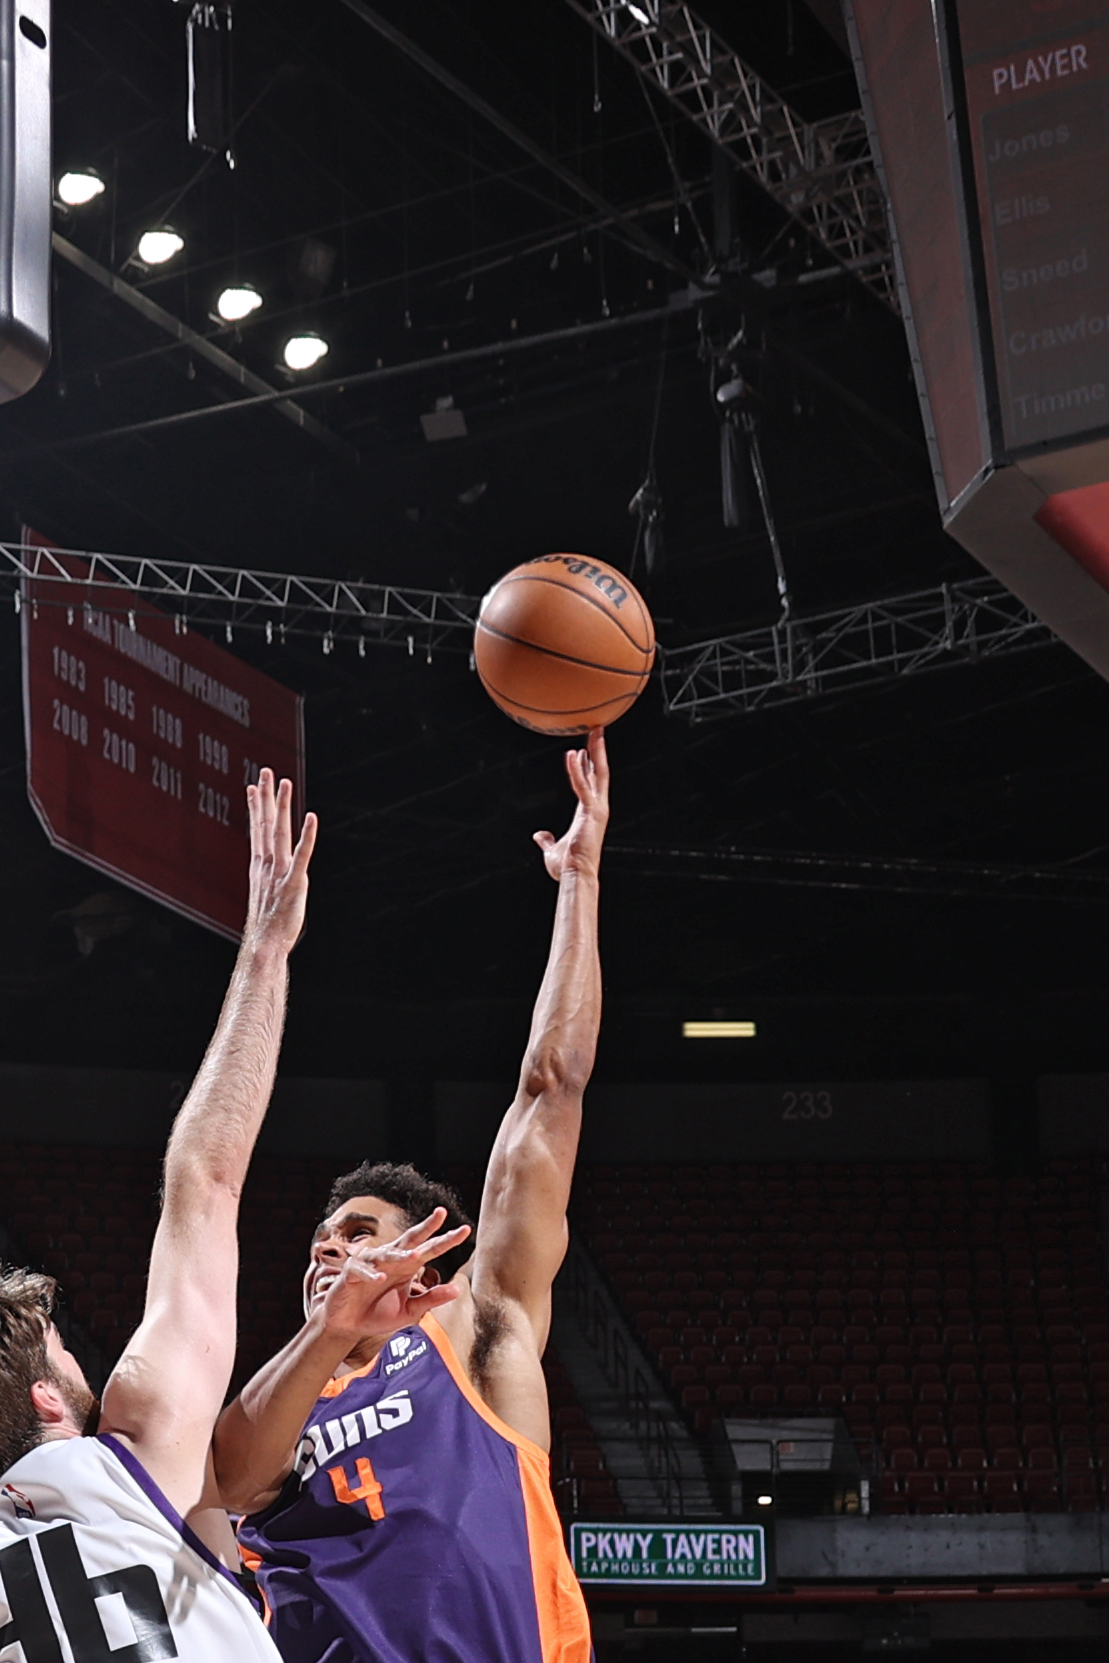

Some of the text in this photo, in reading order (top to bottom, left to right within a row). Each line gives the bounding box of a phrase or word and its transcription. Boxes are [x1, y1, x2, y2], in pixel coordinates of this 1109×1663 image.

[993, 44, 1089, 95] PLAYER
[989, 125, 1071, 162] Jones
[995, 196, 1052, 228] Ellis
[1001, 252, 1089, 292] Sneed
[1013, 382, 1105, 420] Timme
[52, 645, 87, 693] 1983
[103, 676, 136, 722] 1985
[52, 698, 230, 827] 2008 2010 2011 2012
[781, 1091, 833, 1120] 233
[385, 1340, 427, 1376] PayPal
[326, 1456, 386, 1522] 4
[579, 1531, 755, 1561] PKWY TAVERN
[581, 1561, 756, 1577] TAPHOUSE AND GRILLE
